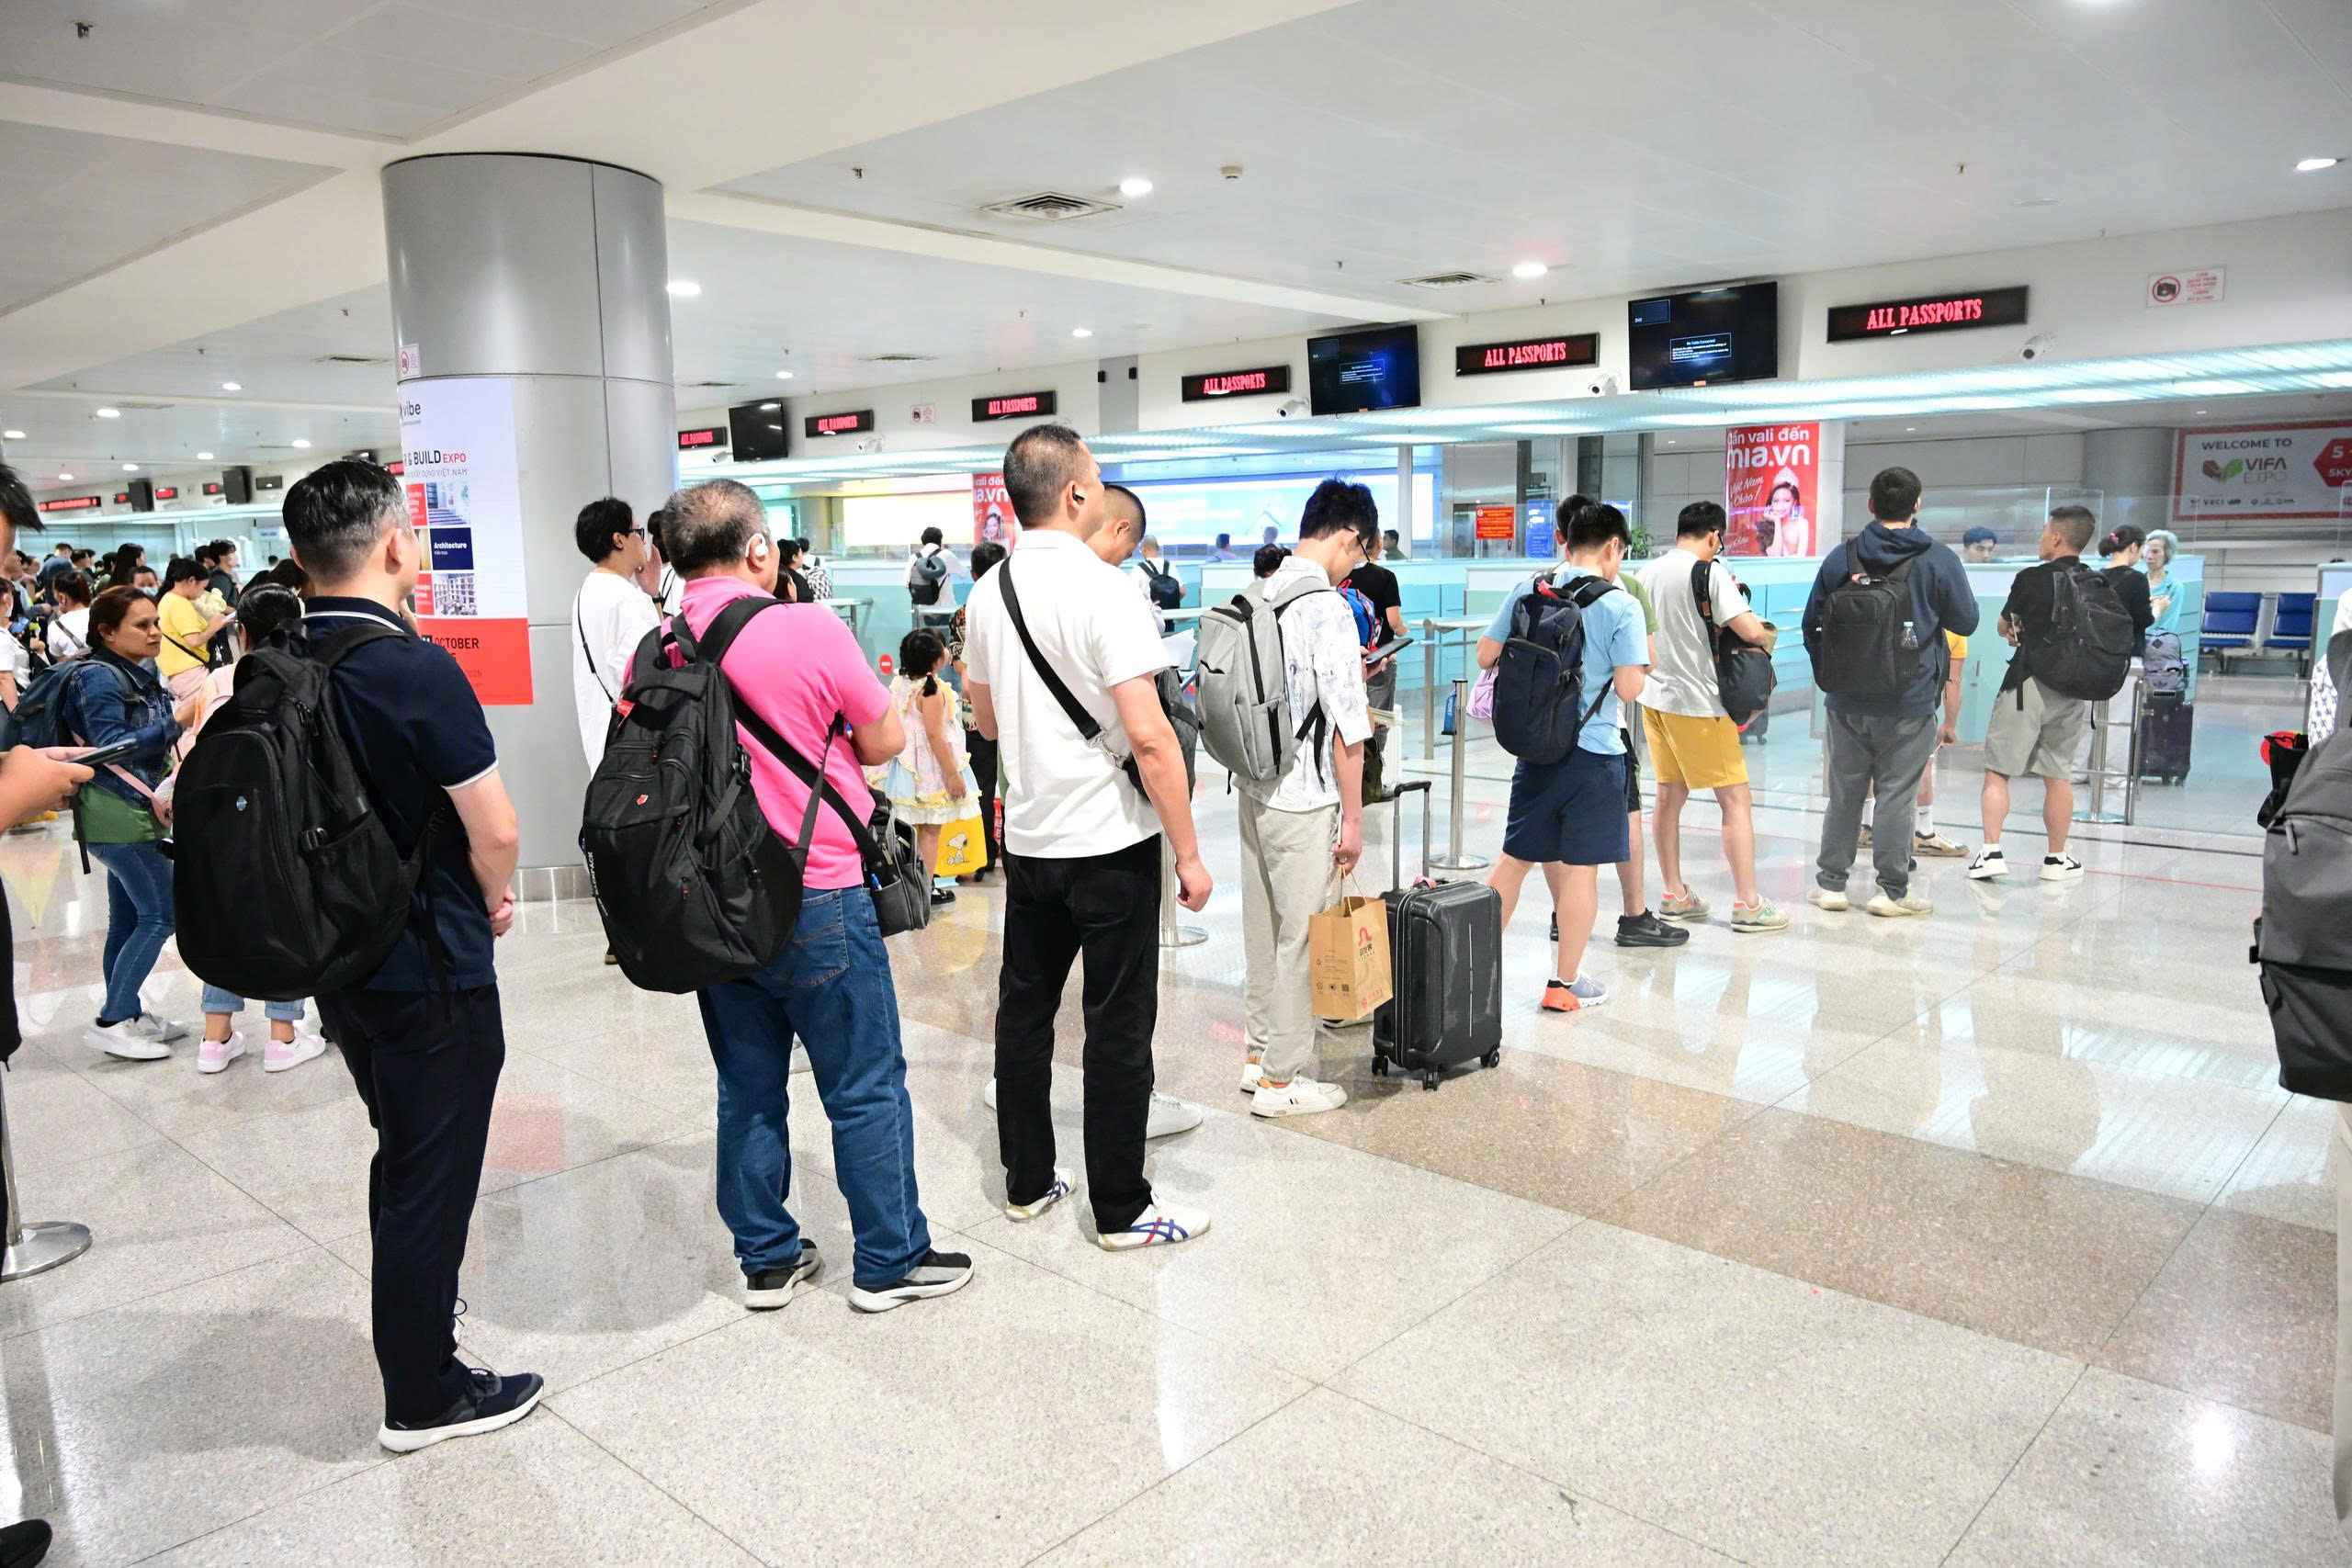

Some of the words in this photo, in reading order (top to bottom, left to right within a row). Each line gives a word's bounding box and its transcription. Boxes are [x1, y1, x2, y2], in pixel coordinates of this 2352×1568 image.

[1866, 308, 1895, 330] ALL
[1900, 298, 1983, 327] PASSPORTS
[1485, 348, 1505, 367] ALL
[1508, 342, 1566, 366] PASSPORTS
[1204, 378, 1220, 394] ALL
[1221, 372, 1265, 391] PASSPORTS
[402, 400, 422, 417] vibe
[988, 400, 1001, 415] ALL
[1002, 396, 1037, 413] PASSPORTS
[818, 418, 827, 433] ALL
[827, 414, 858, 431] PASSPORTS
[1748, 427, 1774, 443] vali
[1779, 424, 1809, 442] đến
[2201, 438, 2271, 451] WELCOME
[2275, 437, 2293, 448] TO
[2332, 446, 2345, 458] 5
[413, 449, 441, 466] BUILD
[442, 453, 467, 464] EXPO
[2245, 457, 2287, 471] VIFA
[2243, 470, 2288, 485] EXPO
[434, 541, 468, 549] Architecture
[435, 637, 480, 649] OCTOBER
